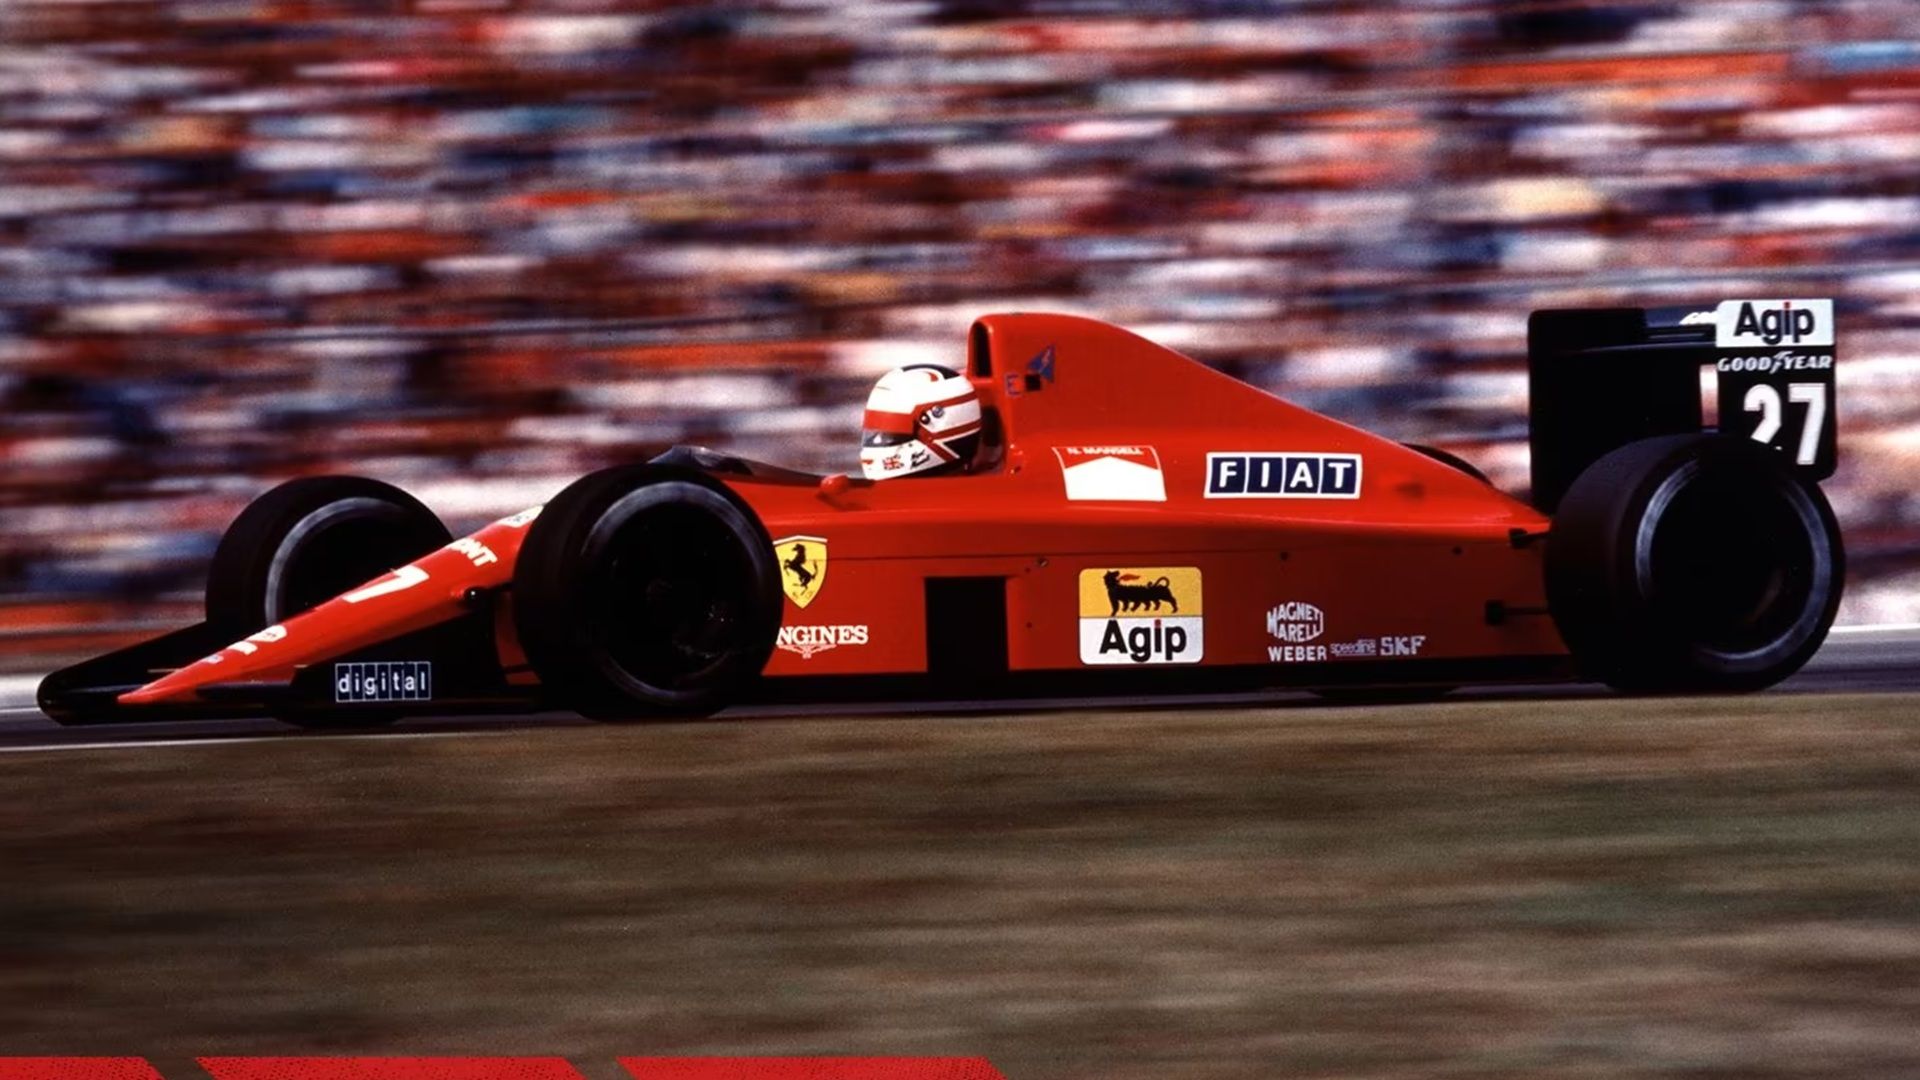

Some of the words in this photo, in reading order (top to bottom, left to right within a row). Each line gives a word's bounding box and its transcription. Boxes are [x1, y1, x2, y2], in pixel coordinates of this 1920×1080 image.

[1733, 301, 1816, 346] Agip
[1717, 351, 1833, 374] GOODYEAR
[1743, 382, 1827, 466] 27
[1218, 461, 1353, 489] FIAT
[776, 625, 869, 645] NGINES
[1099, 619, 1187, 663] Agip
[1268, 645, 1327, 661] WEBER
[1380, 635, 1426, 655] SKF
[338, 671, 427, 696] digital
